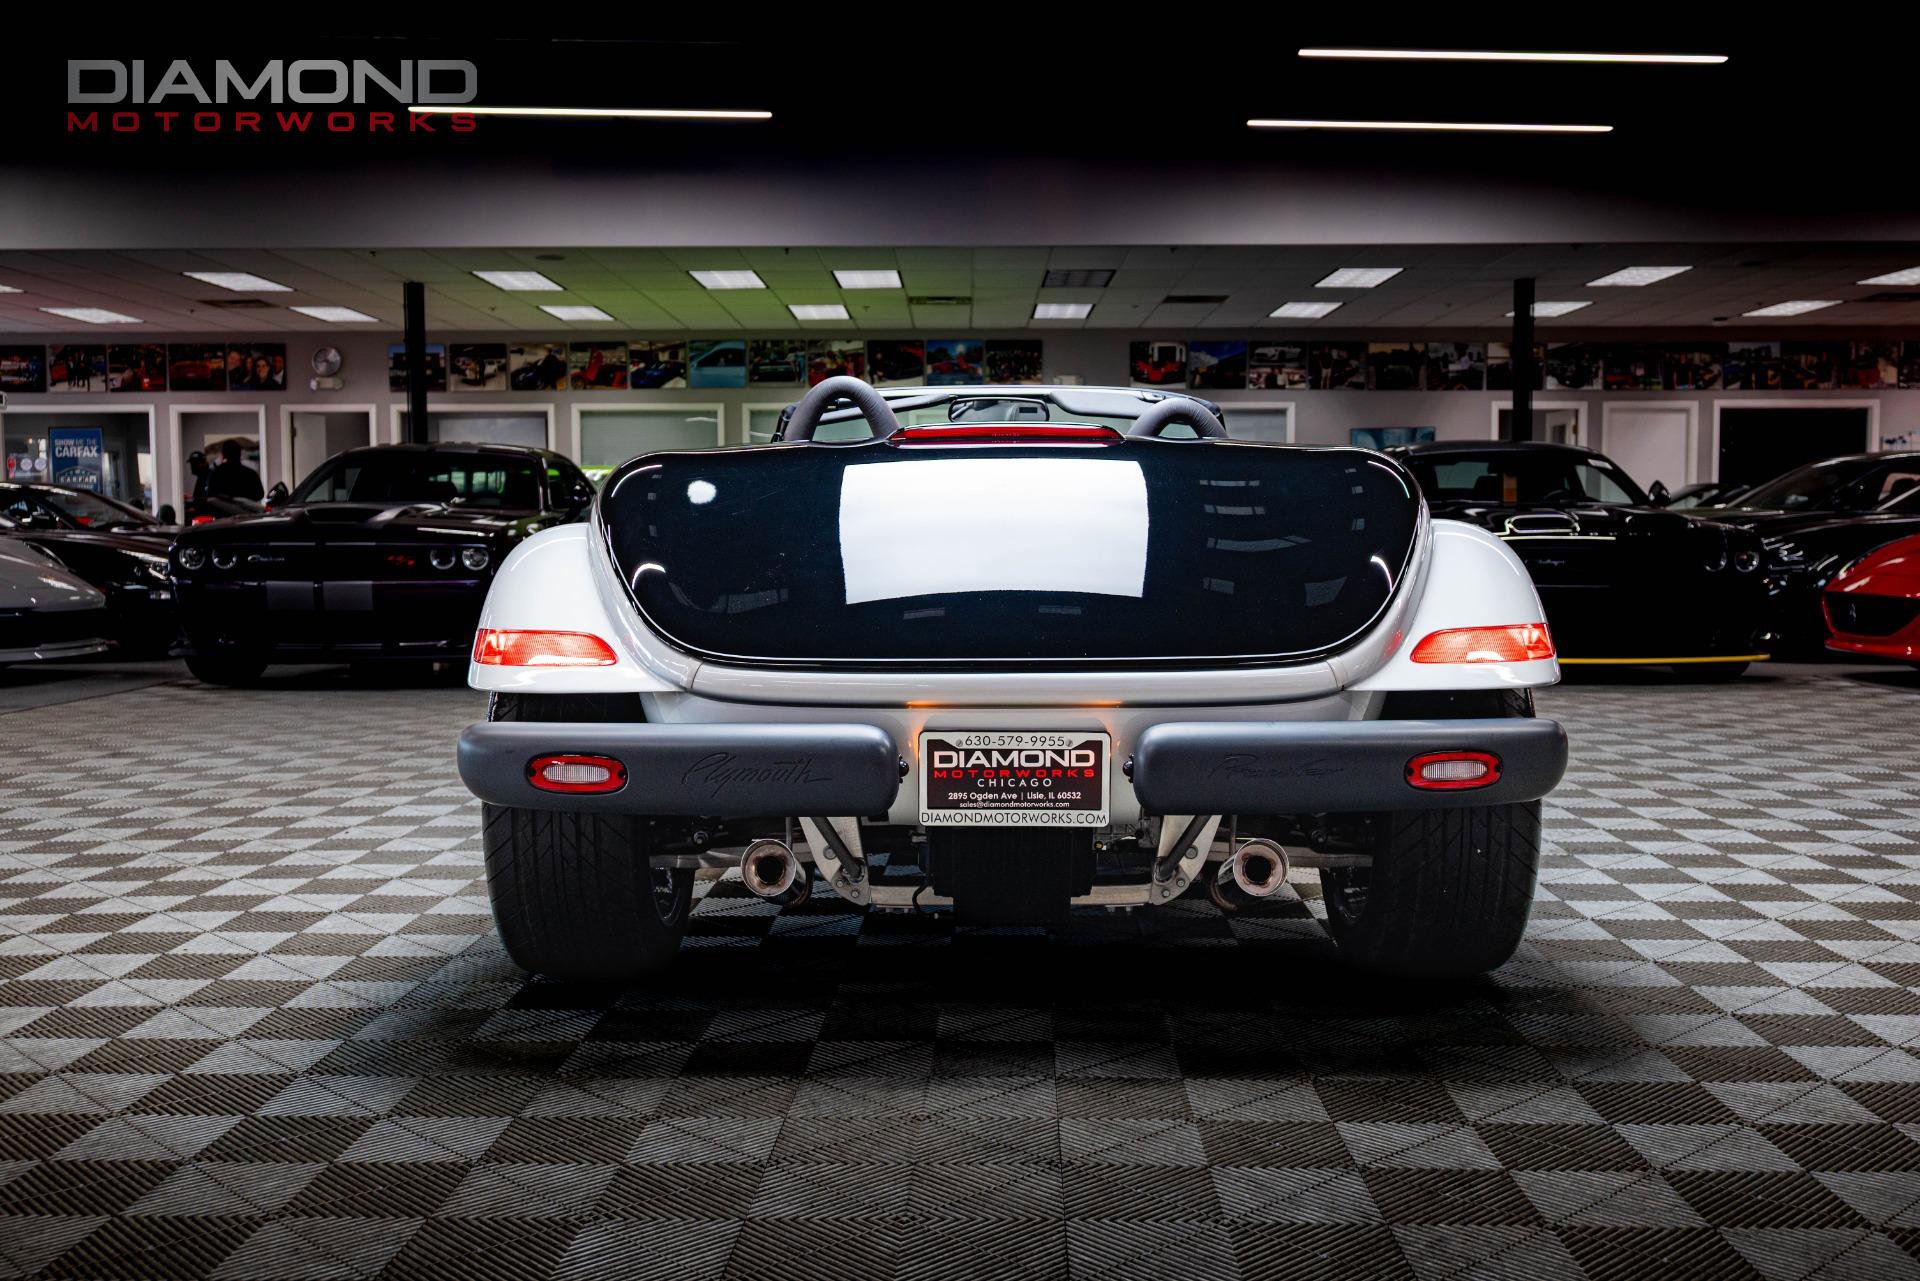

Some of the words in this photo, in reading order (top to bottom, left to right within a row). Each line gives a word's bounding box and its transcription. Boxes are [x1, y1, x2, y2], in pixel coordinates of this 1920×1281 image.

[55, 445, 98, 458] CARFAX
[964, 735, 1065, 747] 630-579-9955
[933, 750, 1096, 768] DIAMOND
[682, 752, 832, 798] Plymouth
[933, 768, 1095, 779] MOTORWORKS
[977, 778, 1053, 787] CHICAGO
[948, 792, 968, 800] 2895
[969, 792, 999, 802] Ogden
[1000, 792, 1018, 800] Ave
[1048, 792, 1056, 800] IL
[1057, 792, 1081, 800] 60532
[959, 800, 1070, 809] sales@diamondmotorworks.com
[921, 812, 1106, 825] DIAMONDMOTORWORKS.COM
